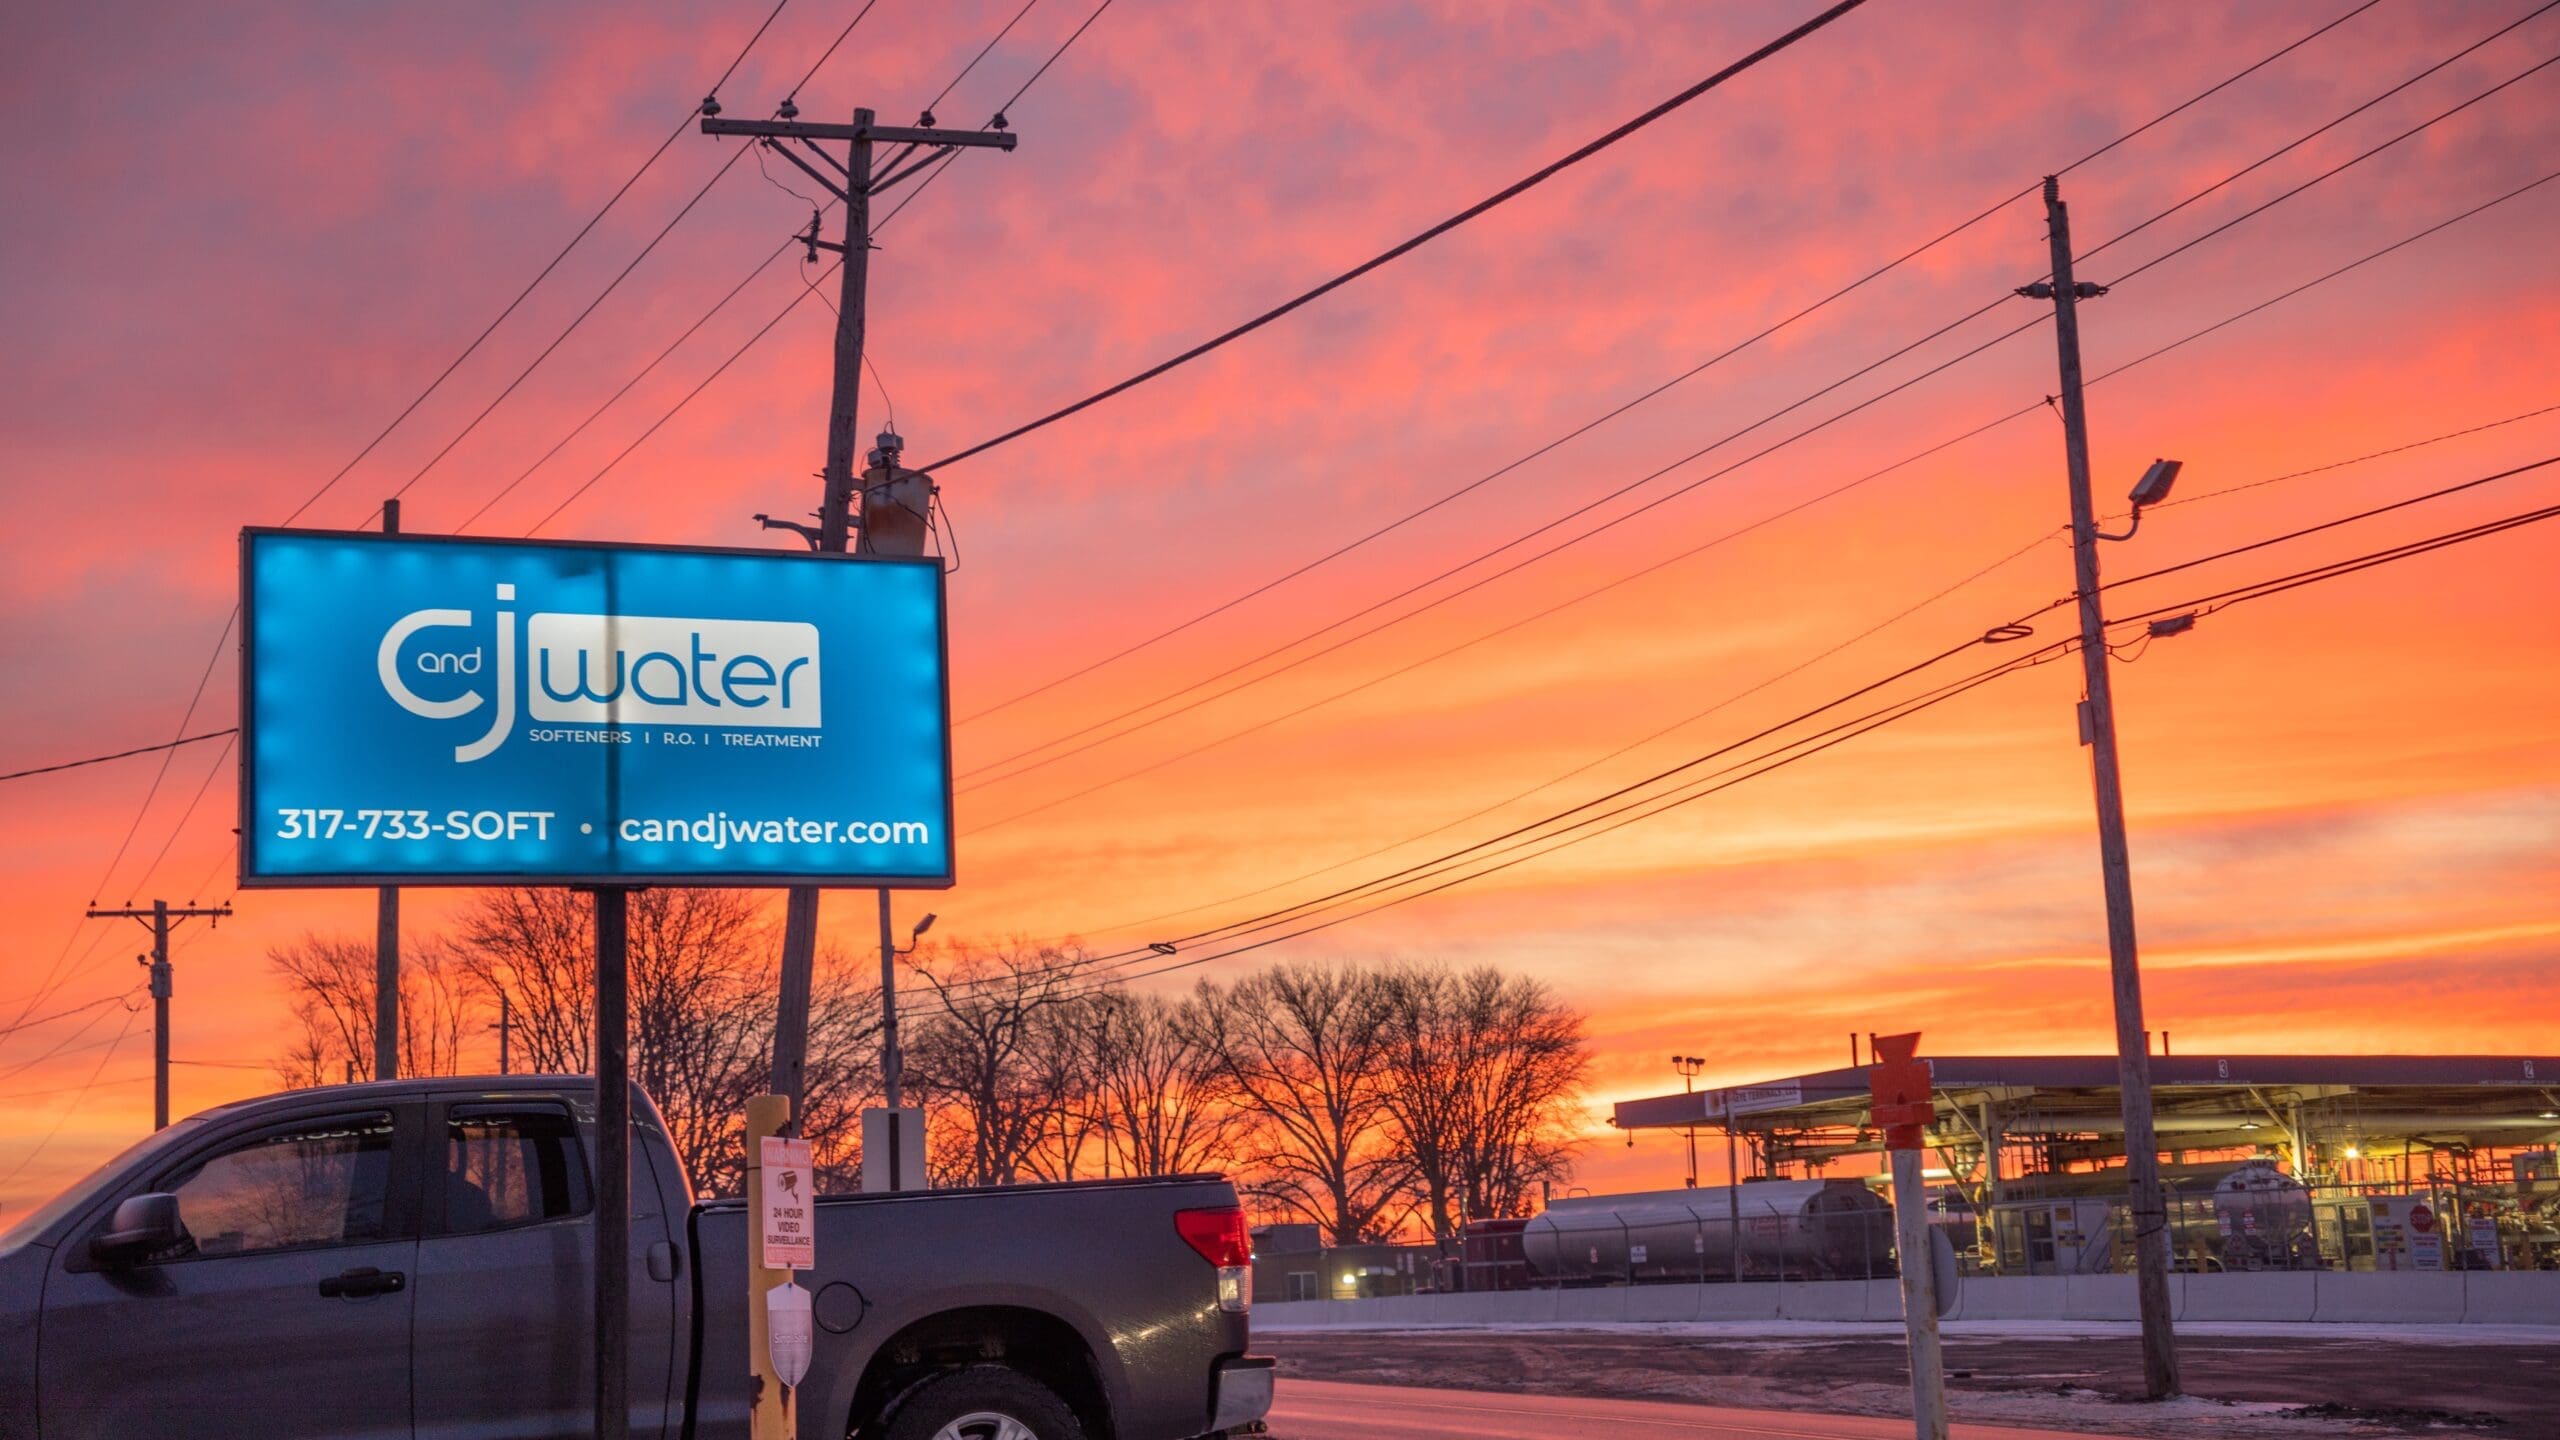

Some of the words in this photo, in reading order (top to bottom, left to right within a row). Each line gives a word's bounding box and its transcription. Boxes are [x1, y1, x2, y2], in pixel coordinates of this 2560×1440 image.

[417, 646, 481, 674] and
[540, 632, 809, 709] water
[529, 729, 632, 744] SOFTENERS
[663, 732, 695, 746] R.O.
[722, 733, 822, 748] TREATMENT
[277, 808, 555, 841] 317-733-SOFT
[619, 812, 929, 850] candjwater.com
[773, 1207, 782, 1218] 24
[784, 1208, 803, 1219] HOUR
[777, 1221, 800, 1232] VIDEO
[767, 1234, 811, 1246] SURVEILLANCE
